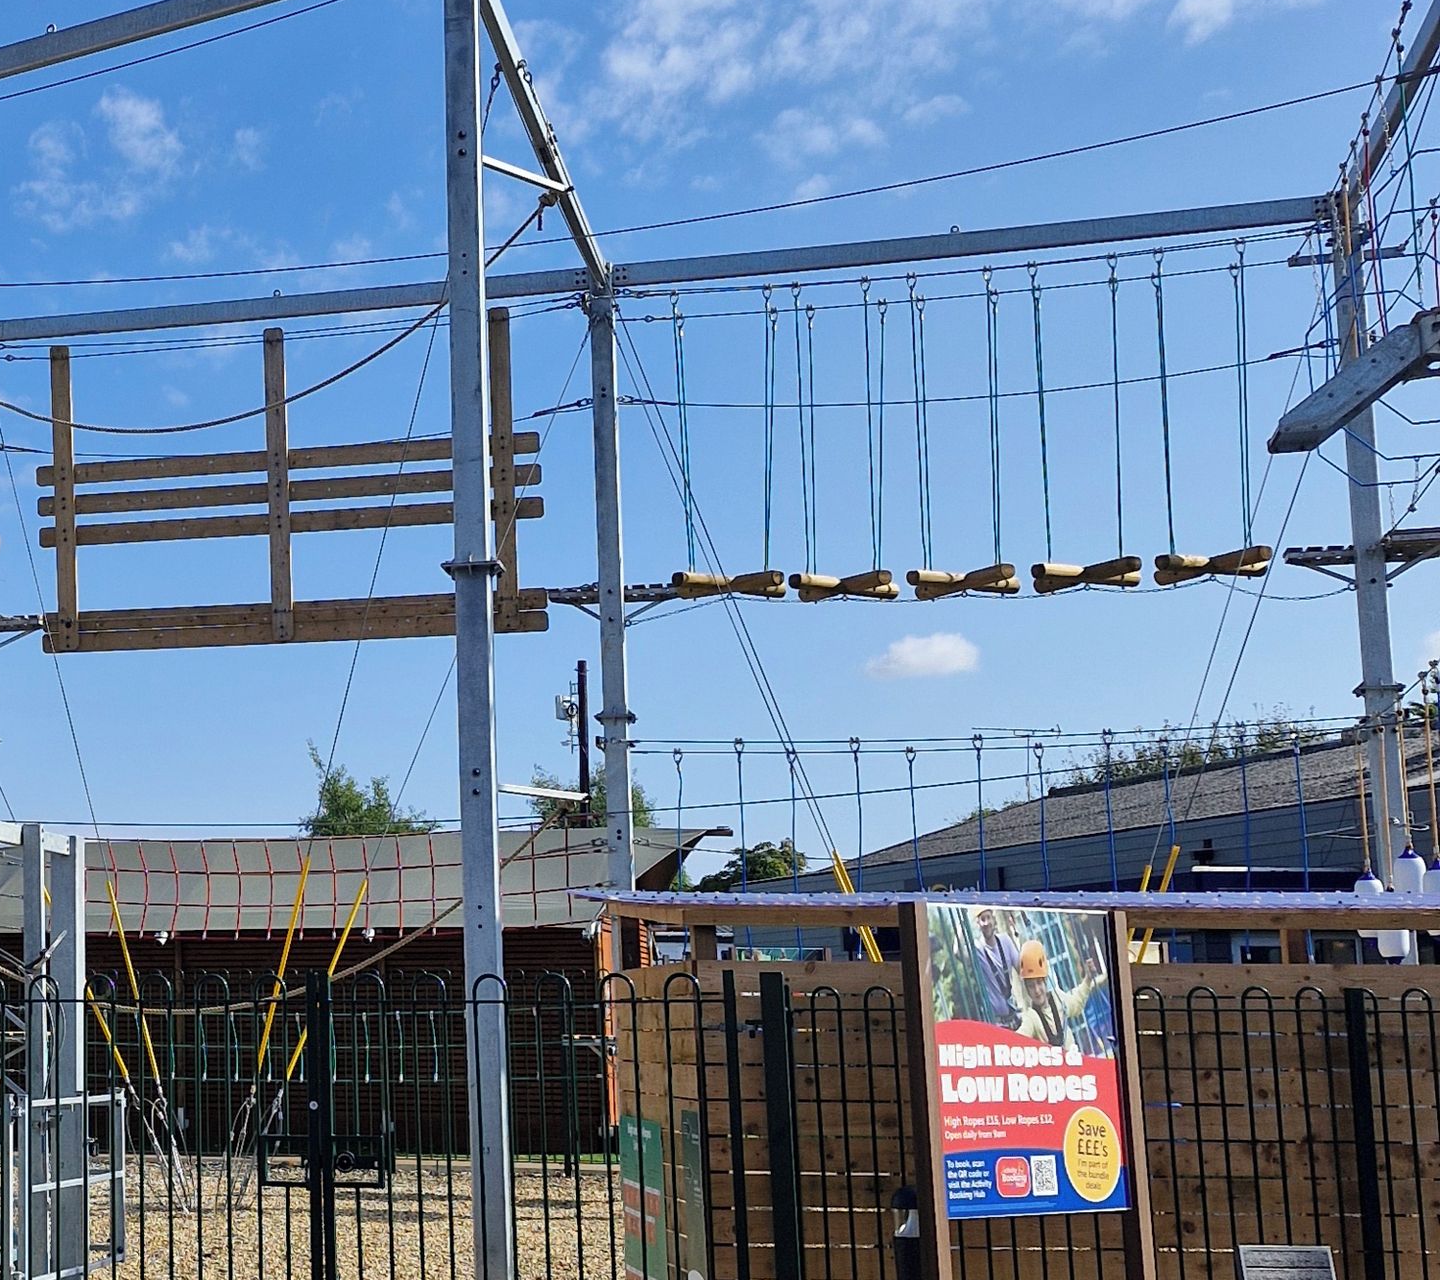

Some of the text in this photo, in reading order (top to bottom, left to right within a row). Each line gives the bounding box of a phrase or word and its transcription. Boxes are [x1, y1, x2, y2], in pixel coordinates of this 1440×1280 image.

[938, 1043, 1083, 1069] High Ropes &
[940, 1073, 1098, 1104] Low Ropes
[943, 1115, 962, 1129] High
[962, 1115, 985, 1127] Ropes
[1001, 1115, 1017, 1126] Low
[1017, 1114, 1039, 1127] Ropes
[1077, 1119, 1107, 1138] Save
[944, 1130, 962, 1141] Open
[962, 1130, 978, 1141] daily
[978, 1130, 993, 1139] from
[1077, 1139, 1109, 1158] £££'s
[946, 1160, 955, 1169] To
[947, 1170, 958, 1179] the
